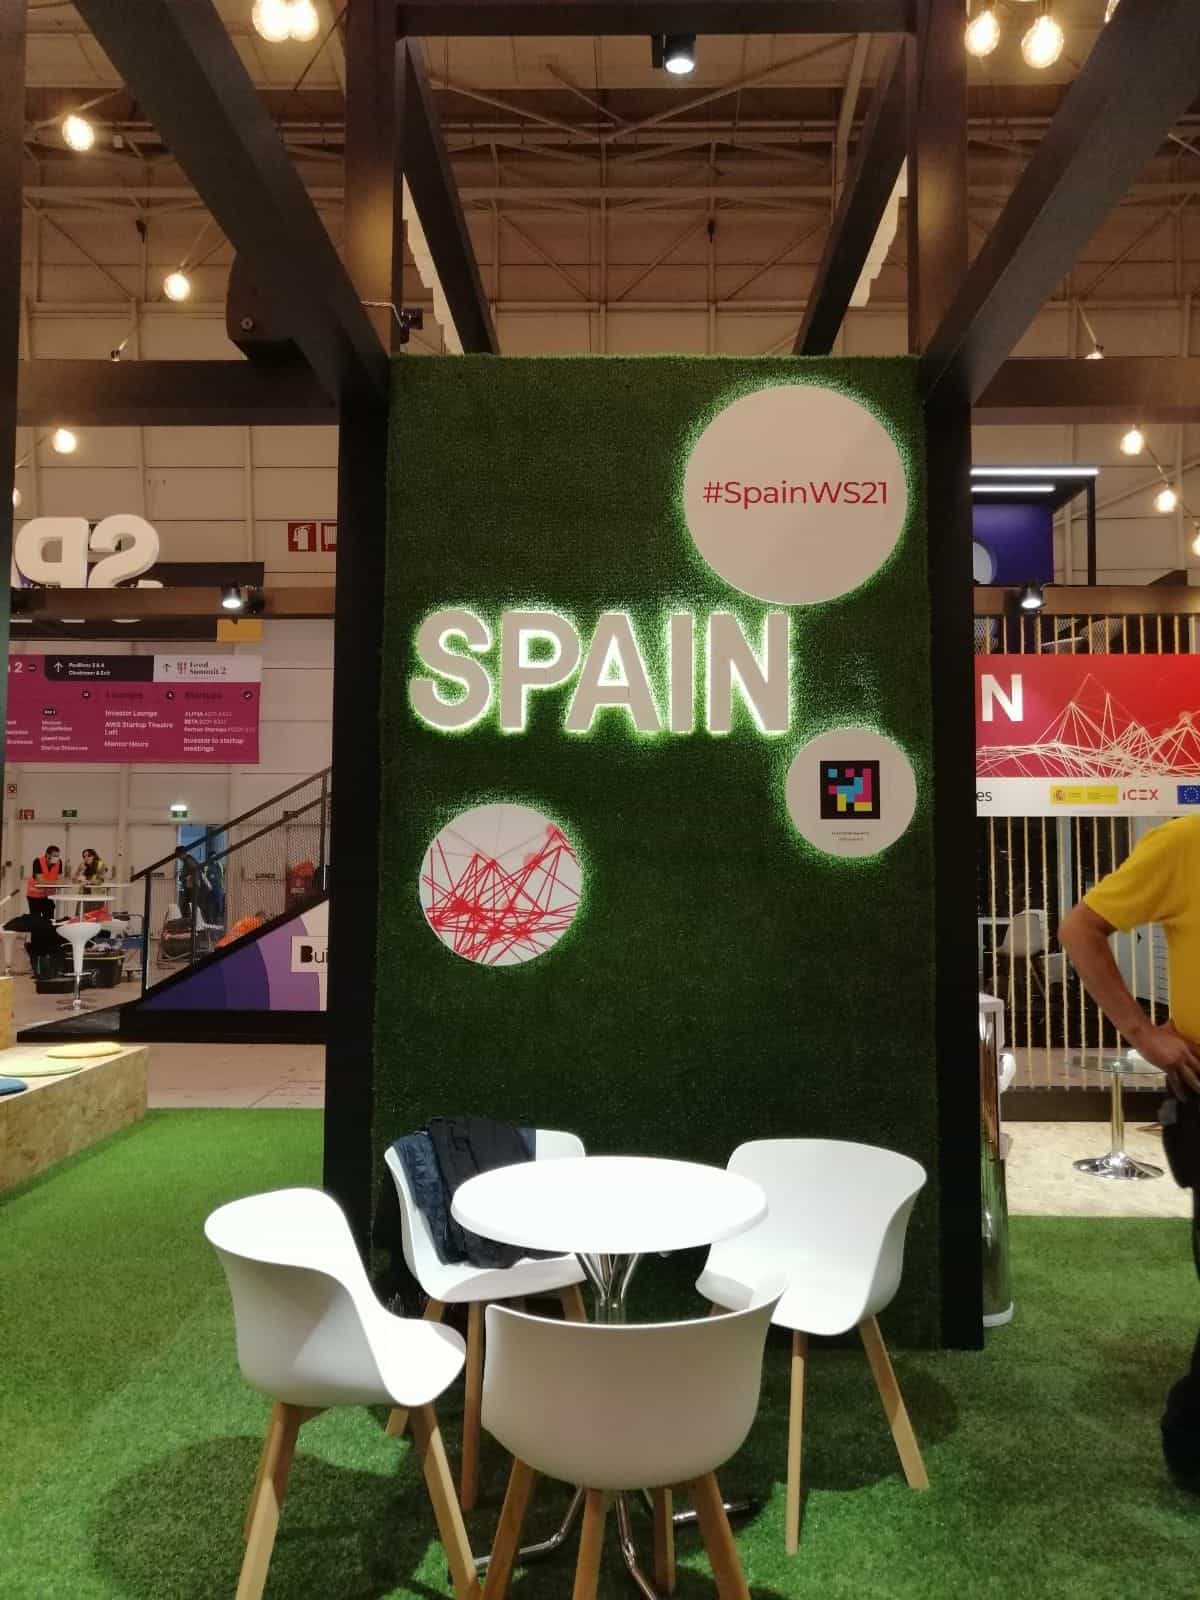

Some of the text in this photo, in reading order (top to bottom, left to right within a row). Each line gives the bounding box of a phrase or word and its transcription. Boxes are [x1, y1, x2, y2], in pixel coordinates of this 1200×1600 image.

[703, 480, 888, 510] #SpainWS21
[409, 609, 792, 731] SPAIN
[981, 674, 1024, 722] N
